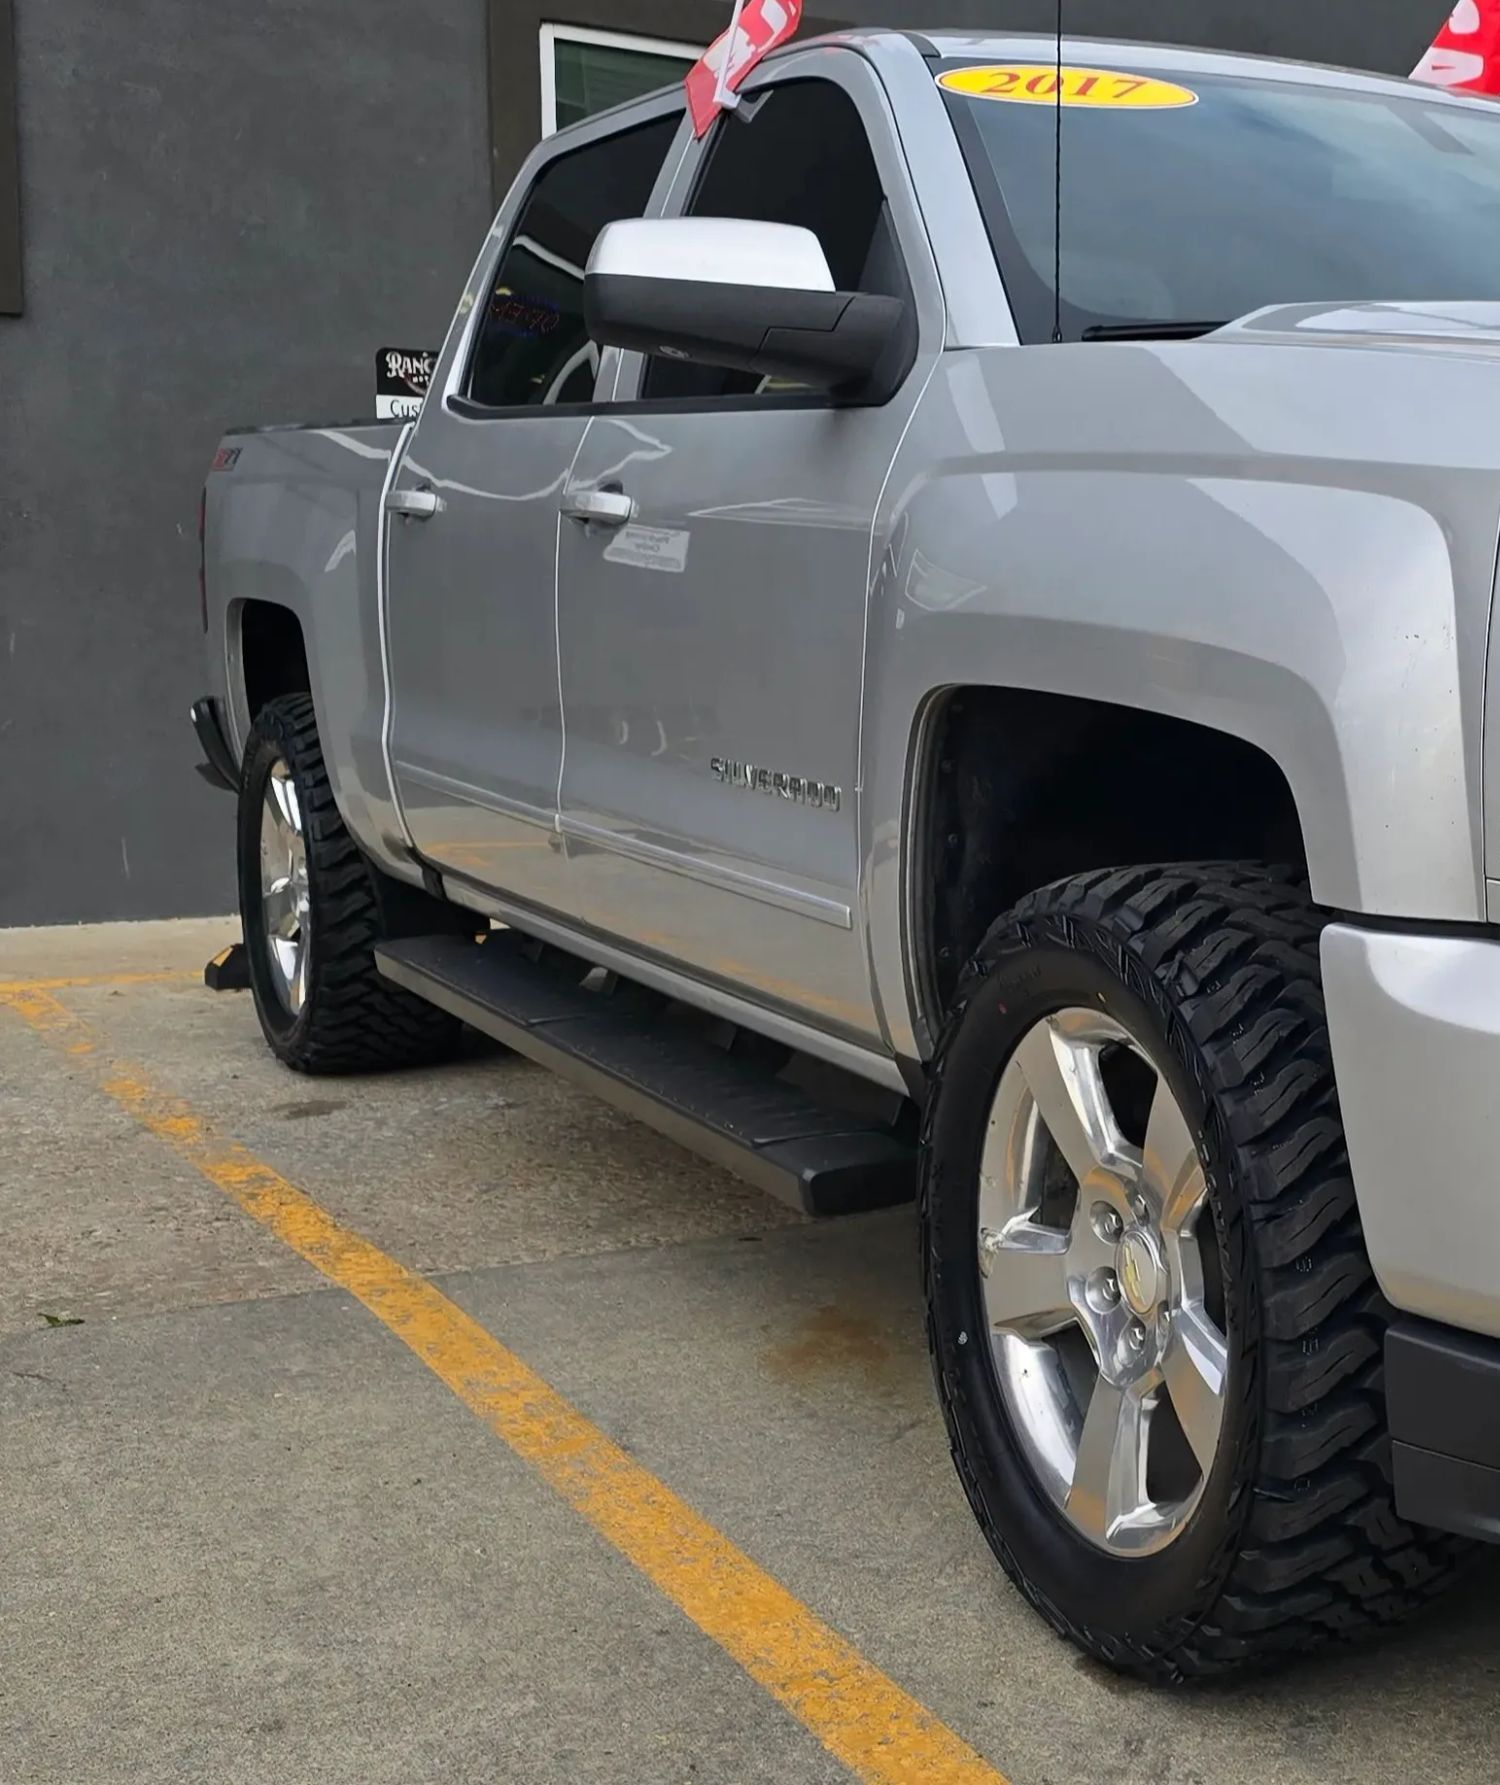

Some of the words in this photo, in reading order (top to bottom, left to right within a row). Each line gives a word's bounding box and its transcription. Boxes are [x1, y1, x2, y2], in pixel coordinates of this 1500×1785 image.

[980, 71, 1149, 99] 2017
[385, 350, 438, 379] RANC
[390, 399, 421, 417] Cus
[710, 757, 842, 813] SILVERADO
